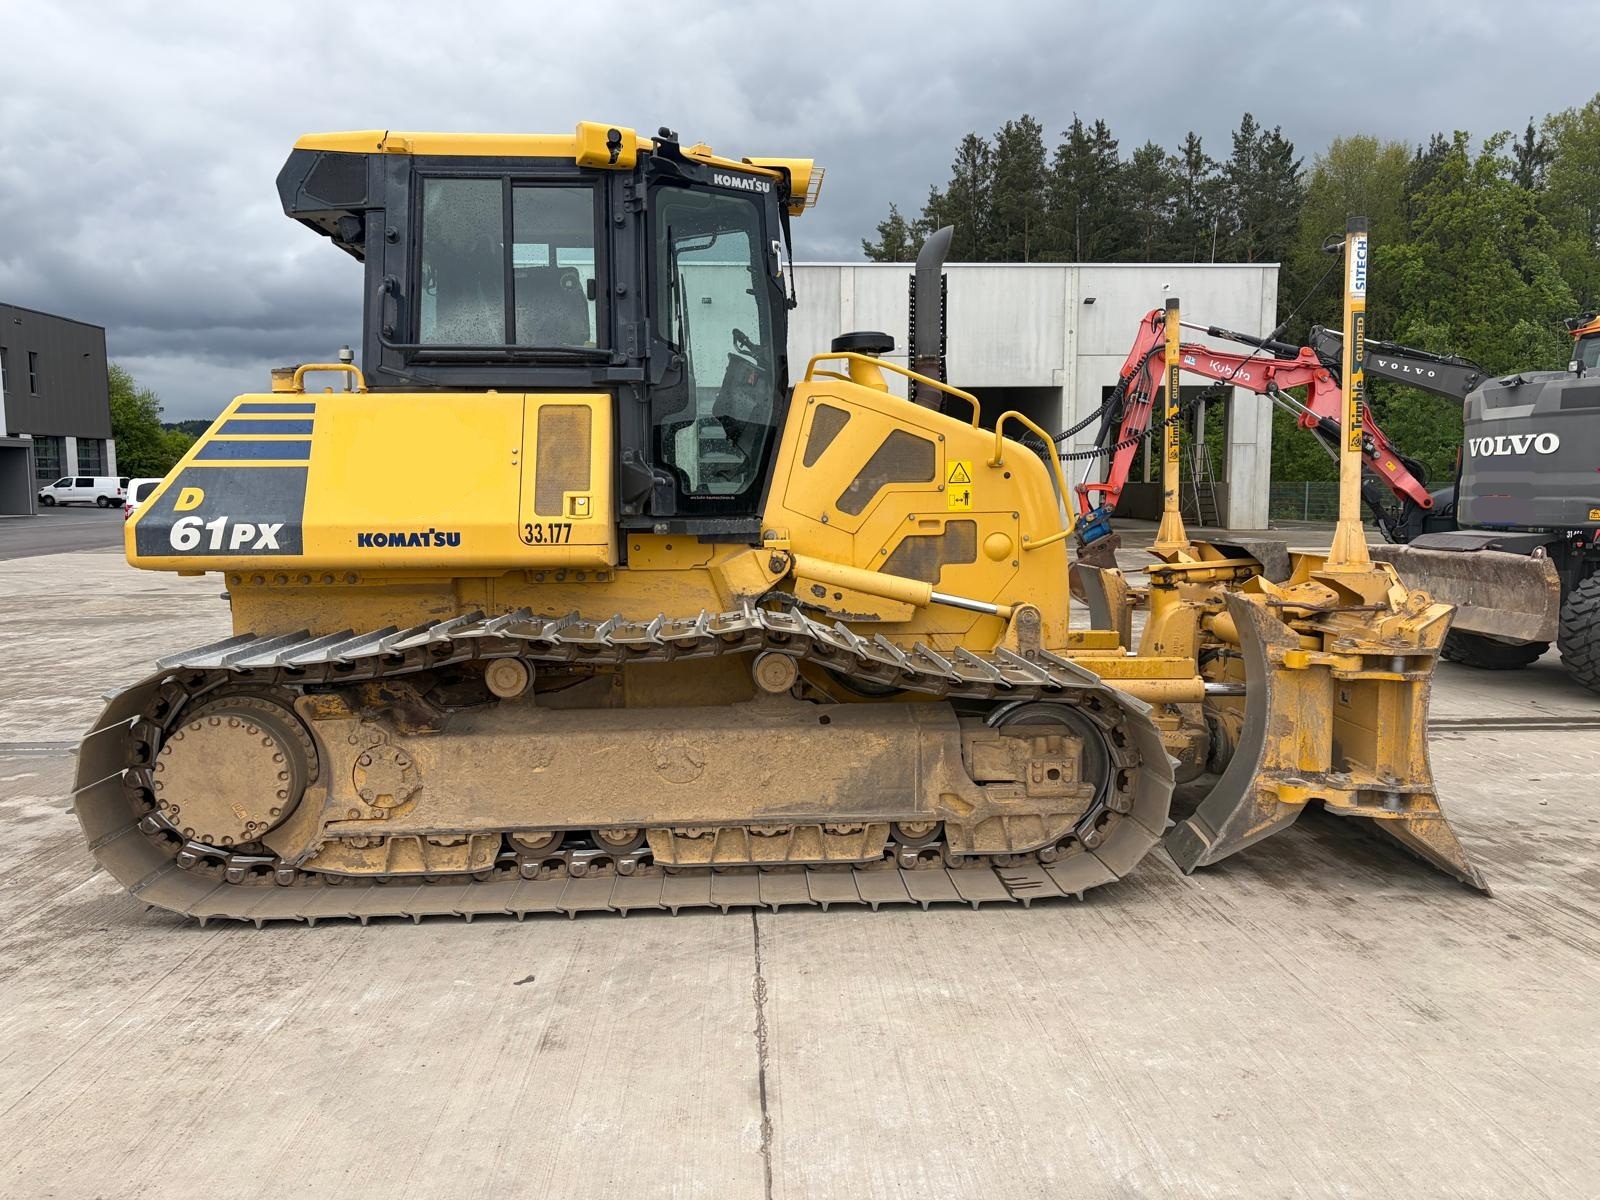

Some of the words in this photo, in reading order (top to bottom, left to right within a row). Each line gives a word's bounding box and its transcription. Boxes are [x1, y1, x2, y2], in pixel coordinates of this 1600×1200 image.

[713, 174, 770, 193] KOMATSU
[1355, 240, 1367, 290] SITECH
[1356, 316, 1364, 362] GUIDED
[1378, 360, 1436, 377] VOLVO
[1351, 380, 1364, 431] Trimble
[1170, 413, 1179, 448] Trimb
[1468, 433, 1560, 457] VOLVO
[173, 487, 205, 512] D
[169, 515, 285, 551] 61PX
[357, 528, 461, 548] KOMATSU
[524, 523, 573, 544] 33.177
